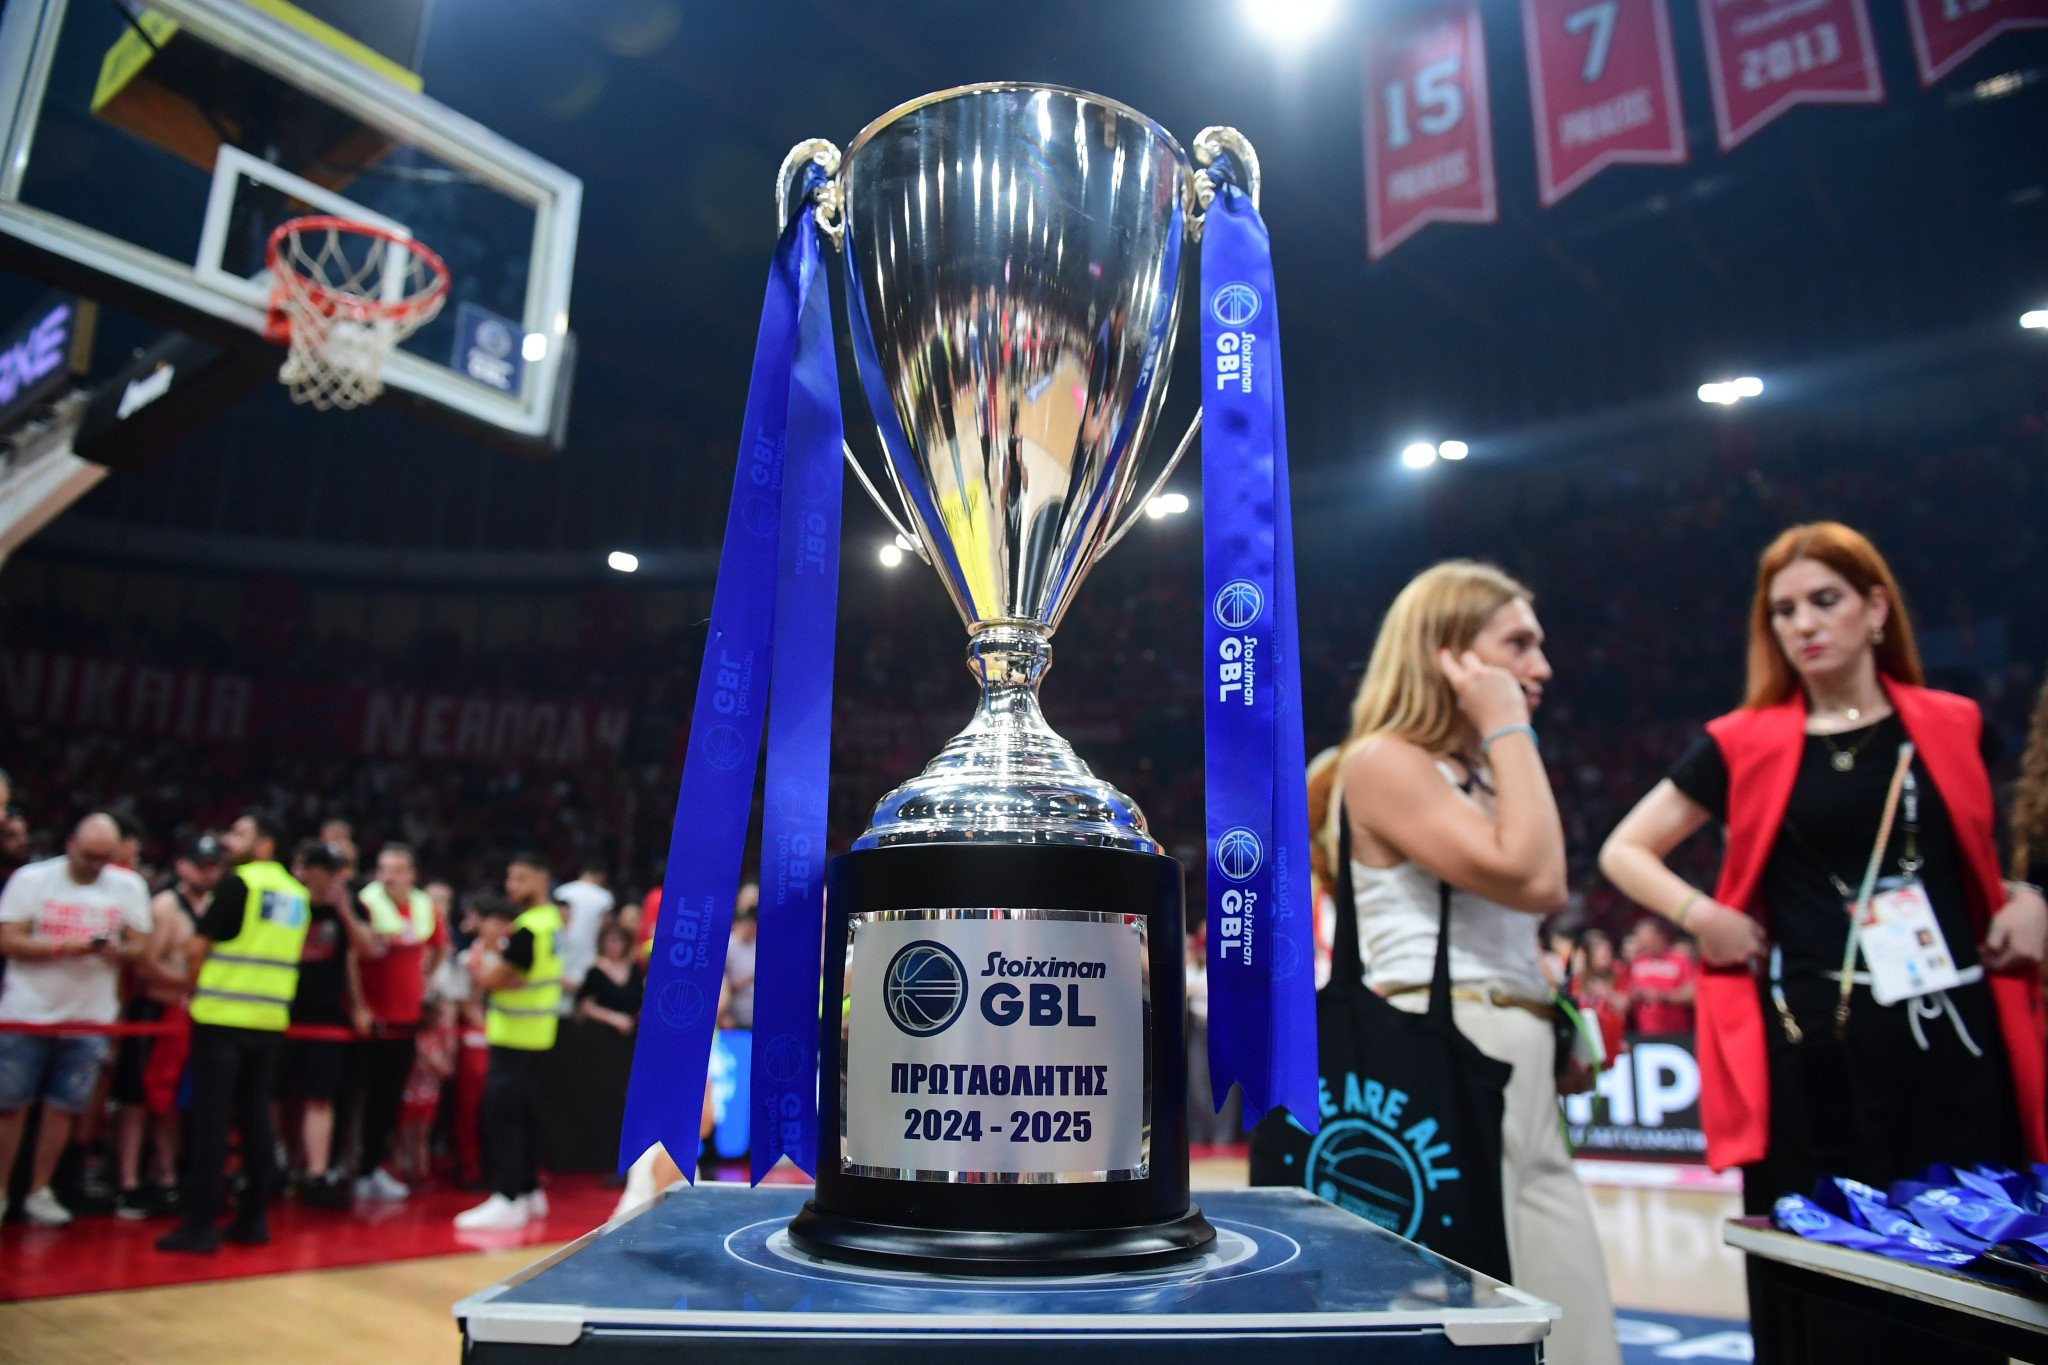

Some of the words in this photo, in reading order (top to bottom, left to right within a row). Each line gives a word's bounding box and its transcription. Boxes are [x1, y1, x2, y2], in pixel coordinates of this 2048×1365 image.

[1563, 0, 1620, 84] 7
[1738, 21, 1843, 92] 2013
[1384, 55, 1463, 151] 15
[1216, 332, 1240, 390] GBL
[1241, 331, 1256, 393] Stoiximan
[1219, 637, 1242, 702] GBL
[1244, 635, 1257, 706] Stoiximan
[1220, 889, 1243, 959] GBL
[1243, 889, 1257, 966] Stoiximan
[981, 952, 1107, 979] Stoiximan
[979, 982, 1097, 1027] GBL
[891, 1063, 1108, 1096] ΠΡΩΤΑΘΛΗΤΗΣ
[904, 1108, 983, 1142] 2024
[1010, 1110, 1092, 1143] 2025
[1344, 1071, 1409, 1130] ARE
[1402, 1116, 1461, 1192] ALL
